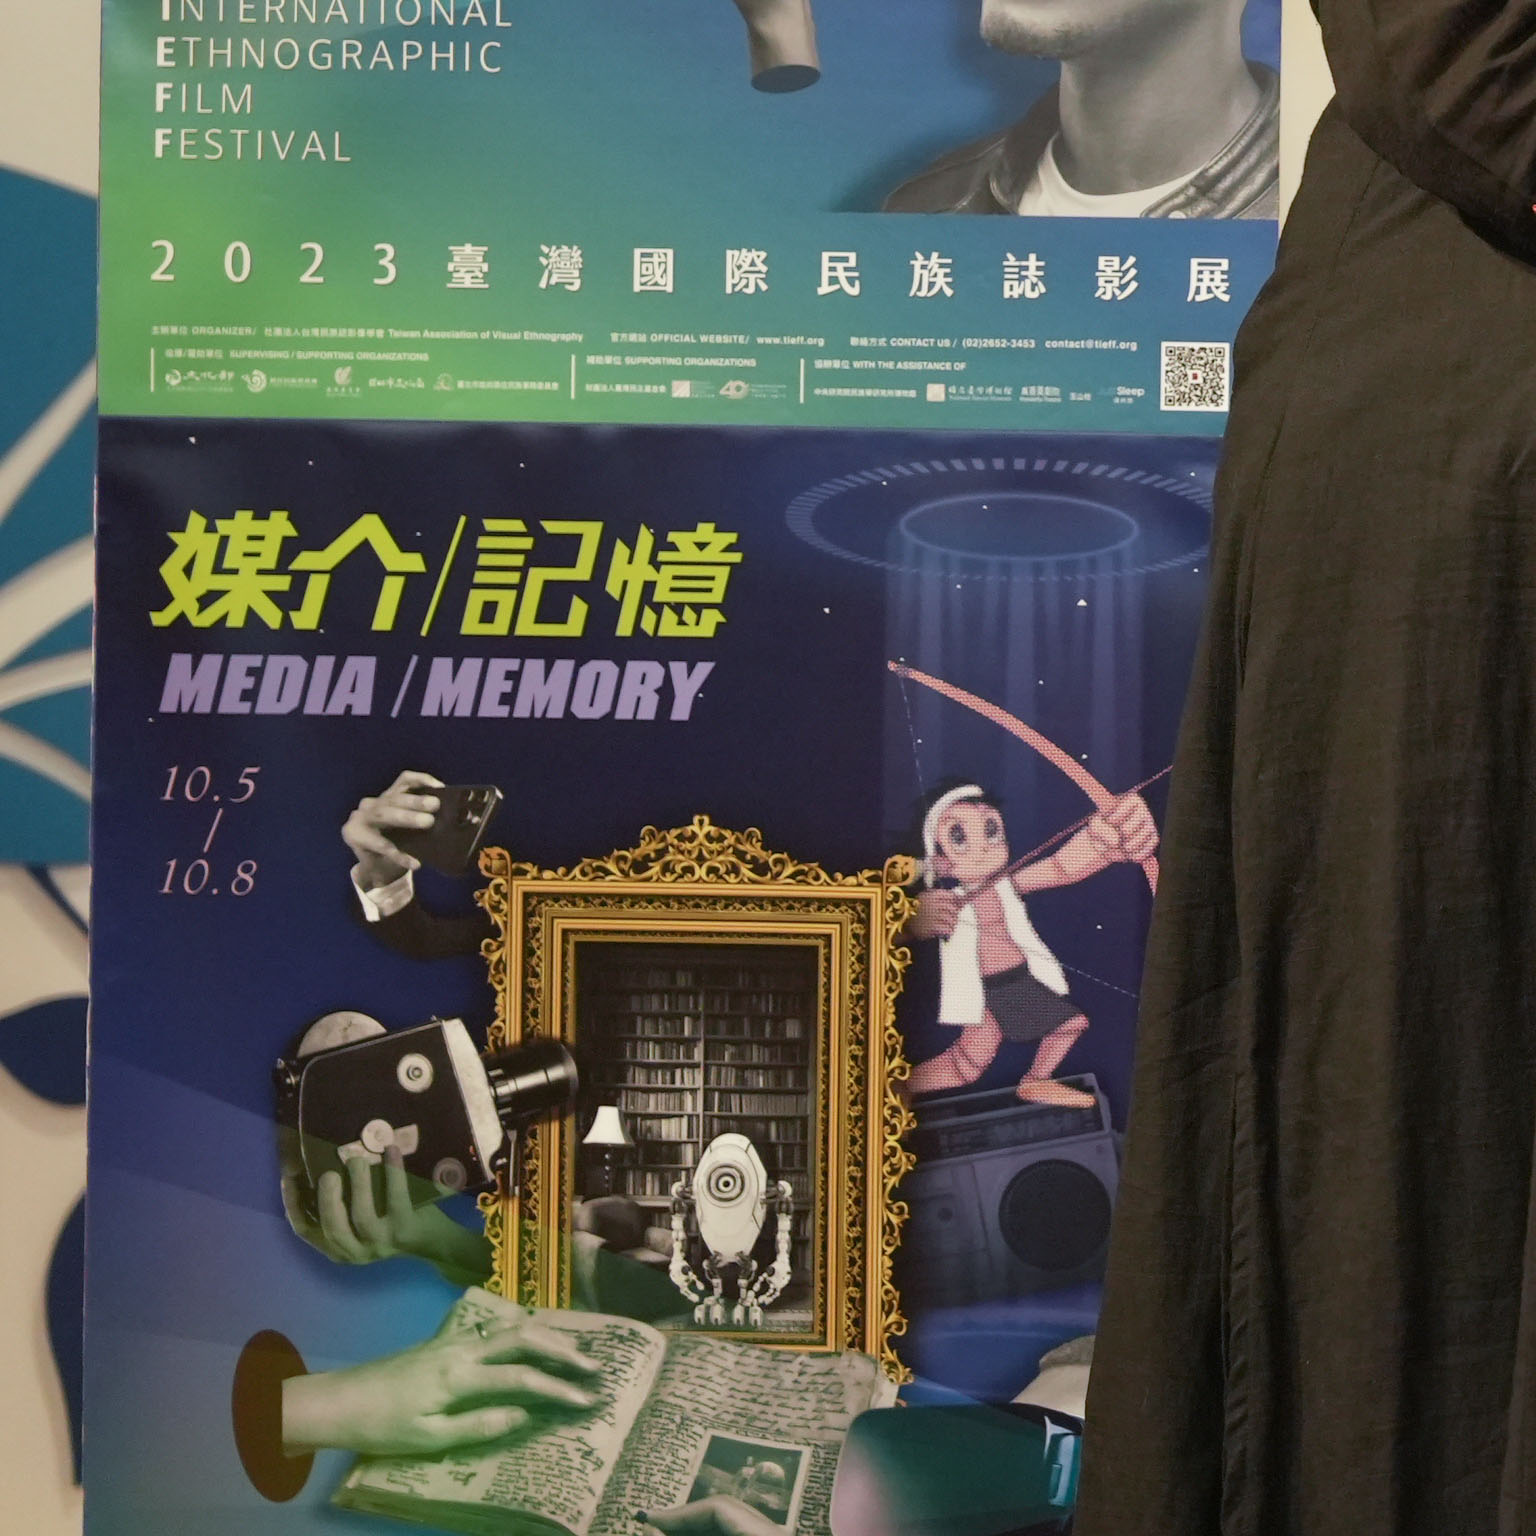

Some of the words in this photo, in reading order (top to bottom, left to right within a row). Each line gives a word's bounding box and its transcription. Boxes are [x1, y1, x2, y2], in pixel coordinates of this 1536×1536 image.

[156, 37, 502, 73] ETHNOGRAPHIC
[155, 83, 252, 114] FILM
[155, 128, 351, 162] FESTIVAL
[422, 329, 478, 340] Association
[480, 330, 490, 340] of
[492, 330, 521, 341] Visual
[523, 331, 583, 343] Ethnography
[650, 333, 696, 343] OFFICIAL
[757, 335, 825, 347] www.tieff.org
[890, 337, 934, 347] CONTACT
[962, 337, 1036, 349] (02)2652-3453
[1045, 338, 1138, 351] contact@tieff.org
[624, 356, 681, 366] SUPPORTING
[684, 357, 757, 367] ORGANIZATIONS
[853, 360, 875, 370] WITH
[877, 360, 895, 370] THE
[896, 361, 952, 371] ASSISTANCE
[953, 362, 967, 371] OF
[158, 653, 377, 716] MEDIA
[420, 657, 716, 721] MEMORY
[158, 766, 261, 803] 10.5
[158, 859, 258, 896] 10.8
